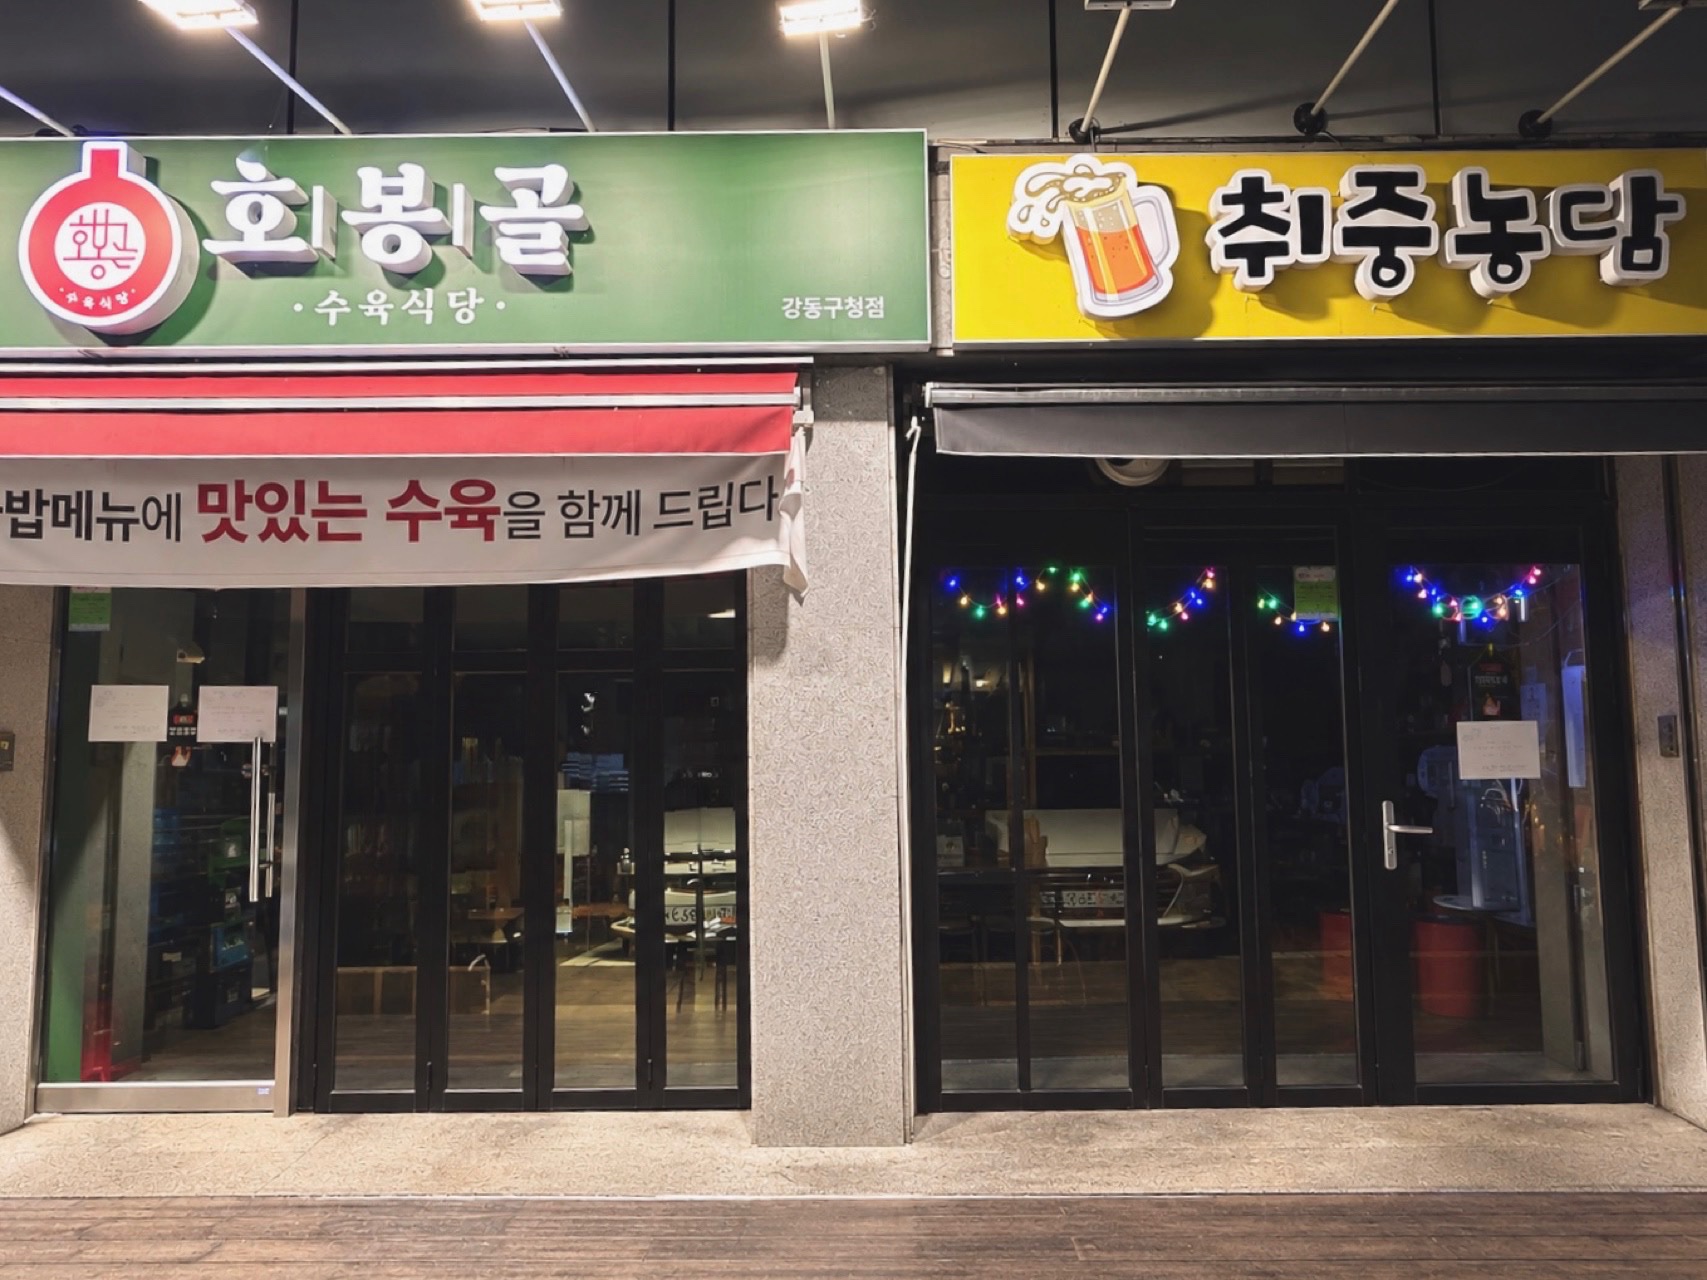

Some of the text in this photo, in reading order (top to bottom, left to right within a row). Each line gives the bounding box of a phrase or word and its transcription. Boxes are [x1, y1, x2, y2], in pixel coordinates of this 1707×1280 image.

[1208, 164, 1686, 299] 취중농담
[313, 287, 485, 326] 수육식당
[781, 295, 885, 319] 강동구청점
[0, 474, 780, 543] 밥메뉴에 맛있는 수육을 함께 드립다
